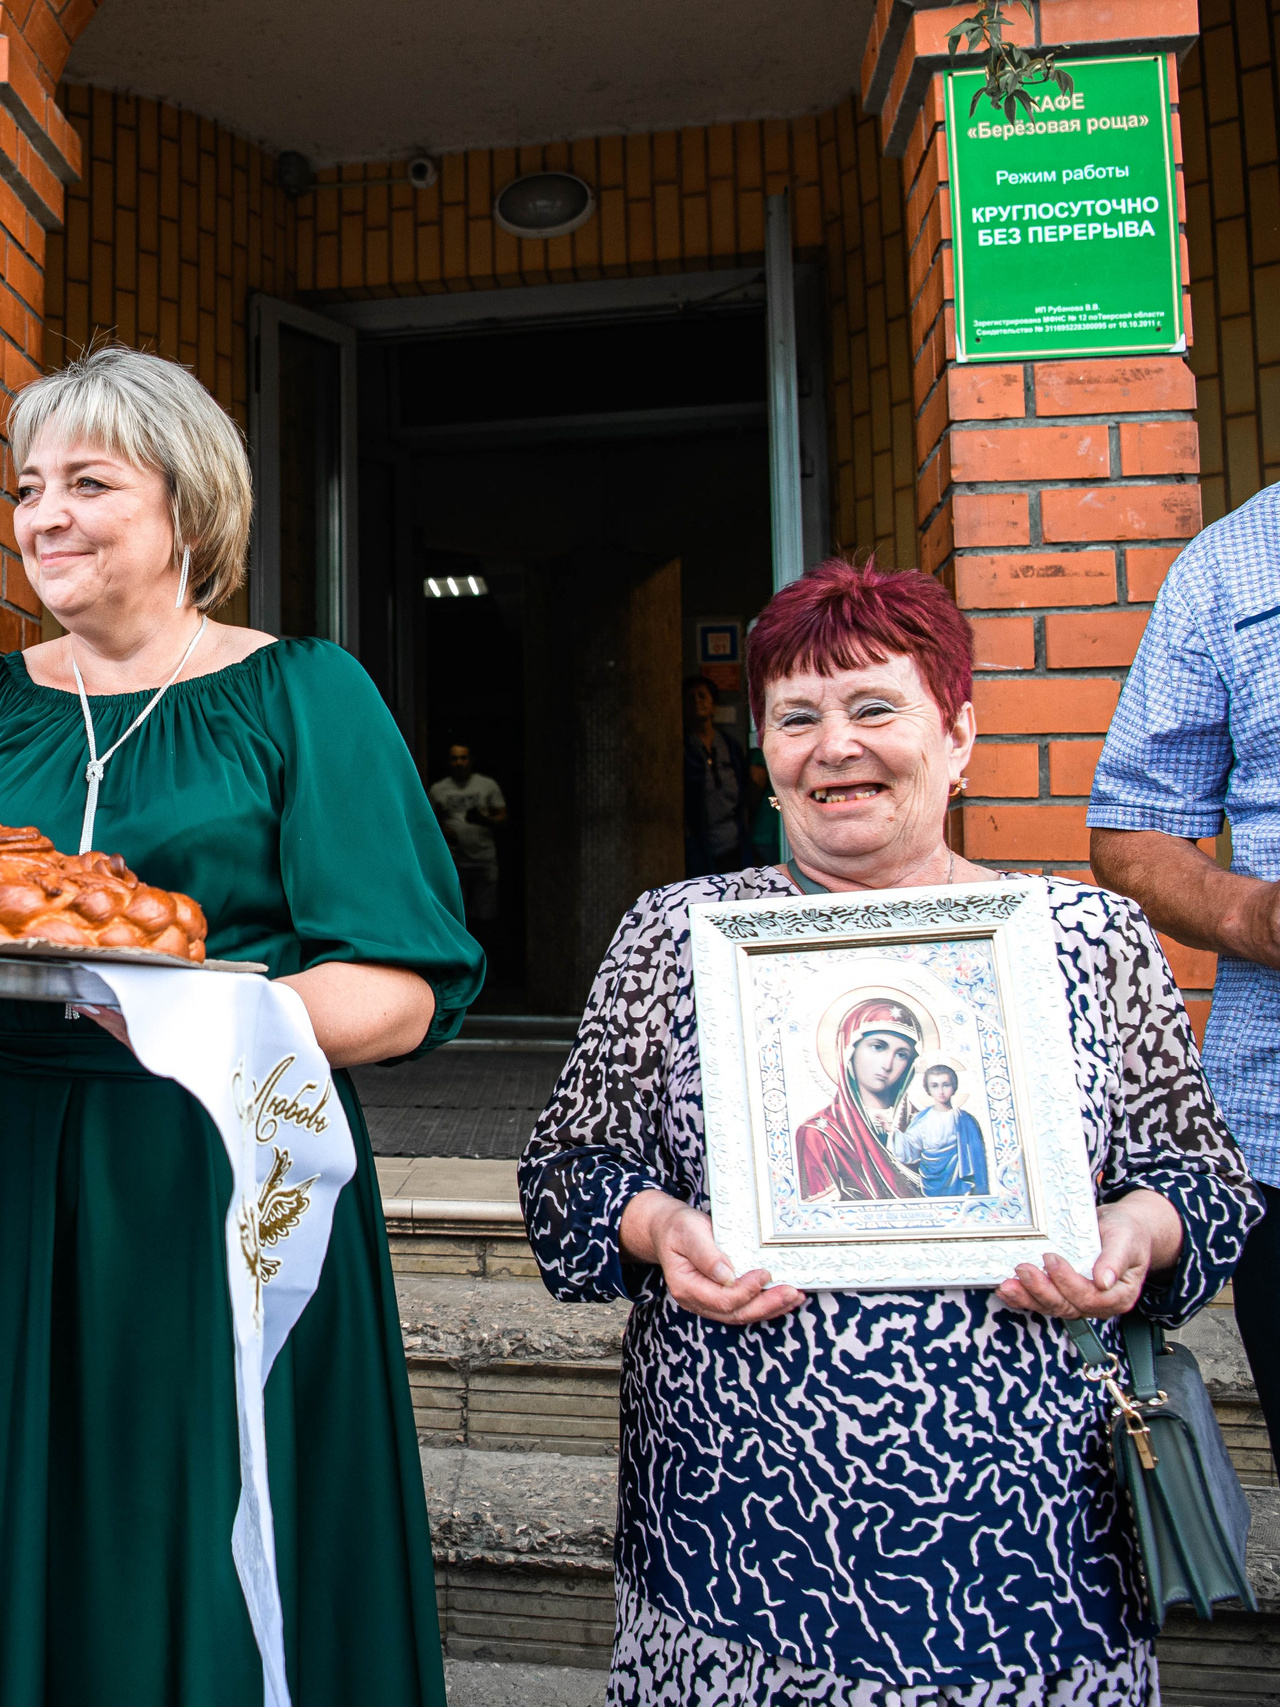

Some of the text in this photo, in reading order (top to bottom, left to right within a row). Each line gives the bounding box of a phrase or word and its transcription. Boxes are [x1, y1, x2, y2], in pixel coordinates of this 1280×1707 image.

[967, 114, 1149, 141] «Берёзовая роща»
[996, 164, 1129, 186] Режим работы
[972, 196, 1160, 224] КРУГЛОСУТОЧНО
[978, 220, 1156, 246] БЕЗ ПЕРЕРЫВА
[973, 317, 1042, 328] Зарегистрирована
[1133, 311, 1165, 319] области
[1035, 306, 1046, 314] ИП
[976, 326, 1033, 336] Свидетельство
